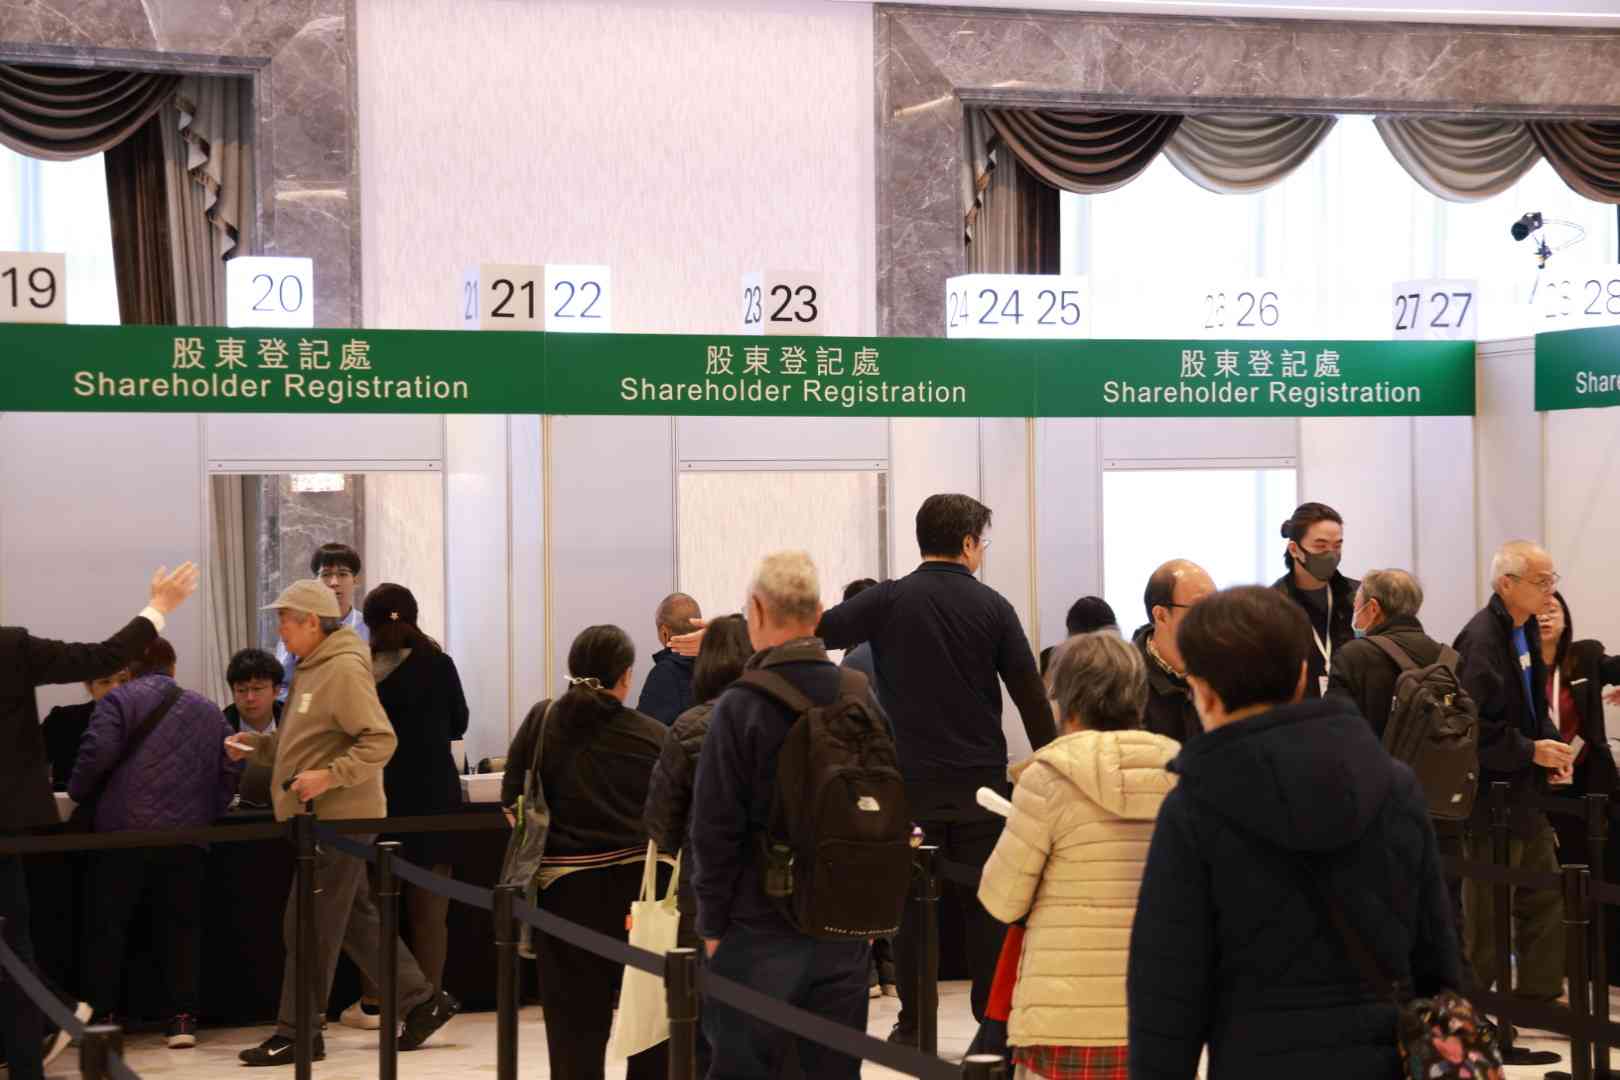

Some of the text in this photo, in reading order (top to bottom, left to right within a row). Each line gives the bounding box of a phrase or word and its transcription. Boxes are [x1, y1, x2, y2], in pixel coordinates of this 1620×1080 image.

[2, 266, 57, 309] 19
[252, 273, 303, 312] 20
[490, 278, 535, 319] 21
[553, 280, 602, 319] 22
[744, 285, 762, 324] 23
[770, 284, 818, 322] 23
[978, 288, 1024, 325] 24
[1037, 289, 1080, 326] 25
[1237, 291, 1279, 327] 26
[1395, 293, 1420, 330] 27
[1430, 292, 1472, 327] 27
[172, 337, 371, 371] 股東登記處
[705, 344, 880, 377] 股東登記處
[1180, 349, 1340, 378] 股東登記處
[74, 371, 469, 404] Shareholder Registration
[620, 377, 966, 407] Shareholder Registration
[1103, 381, 1421, 407] Shareholder Registration
